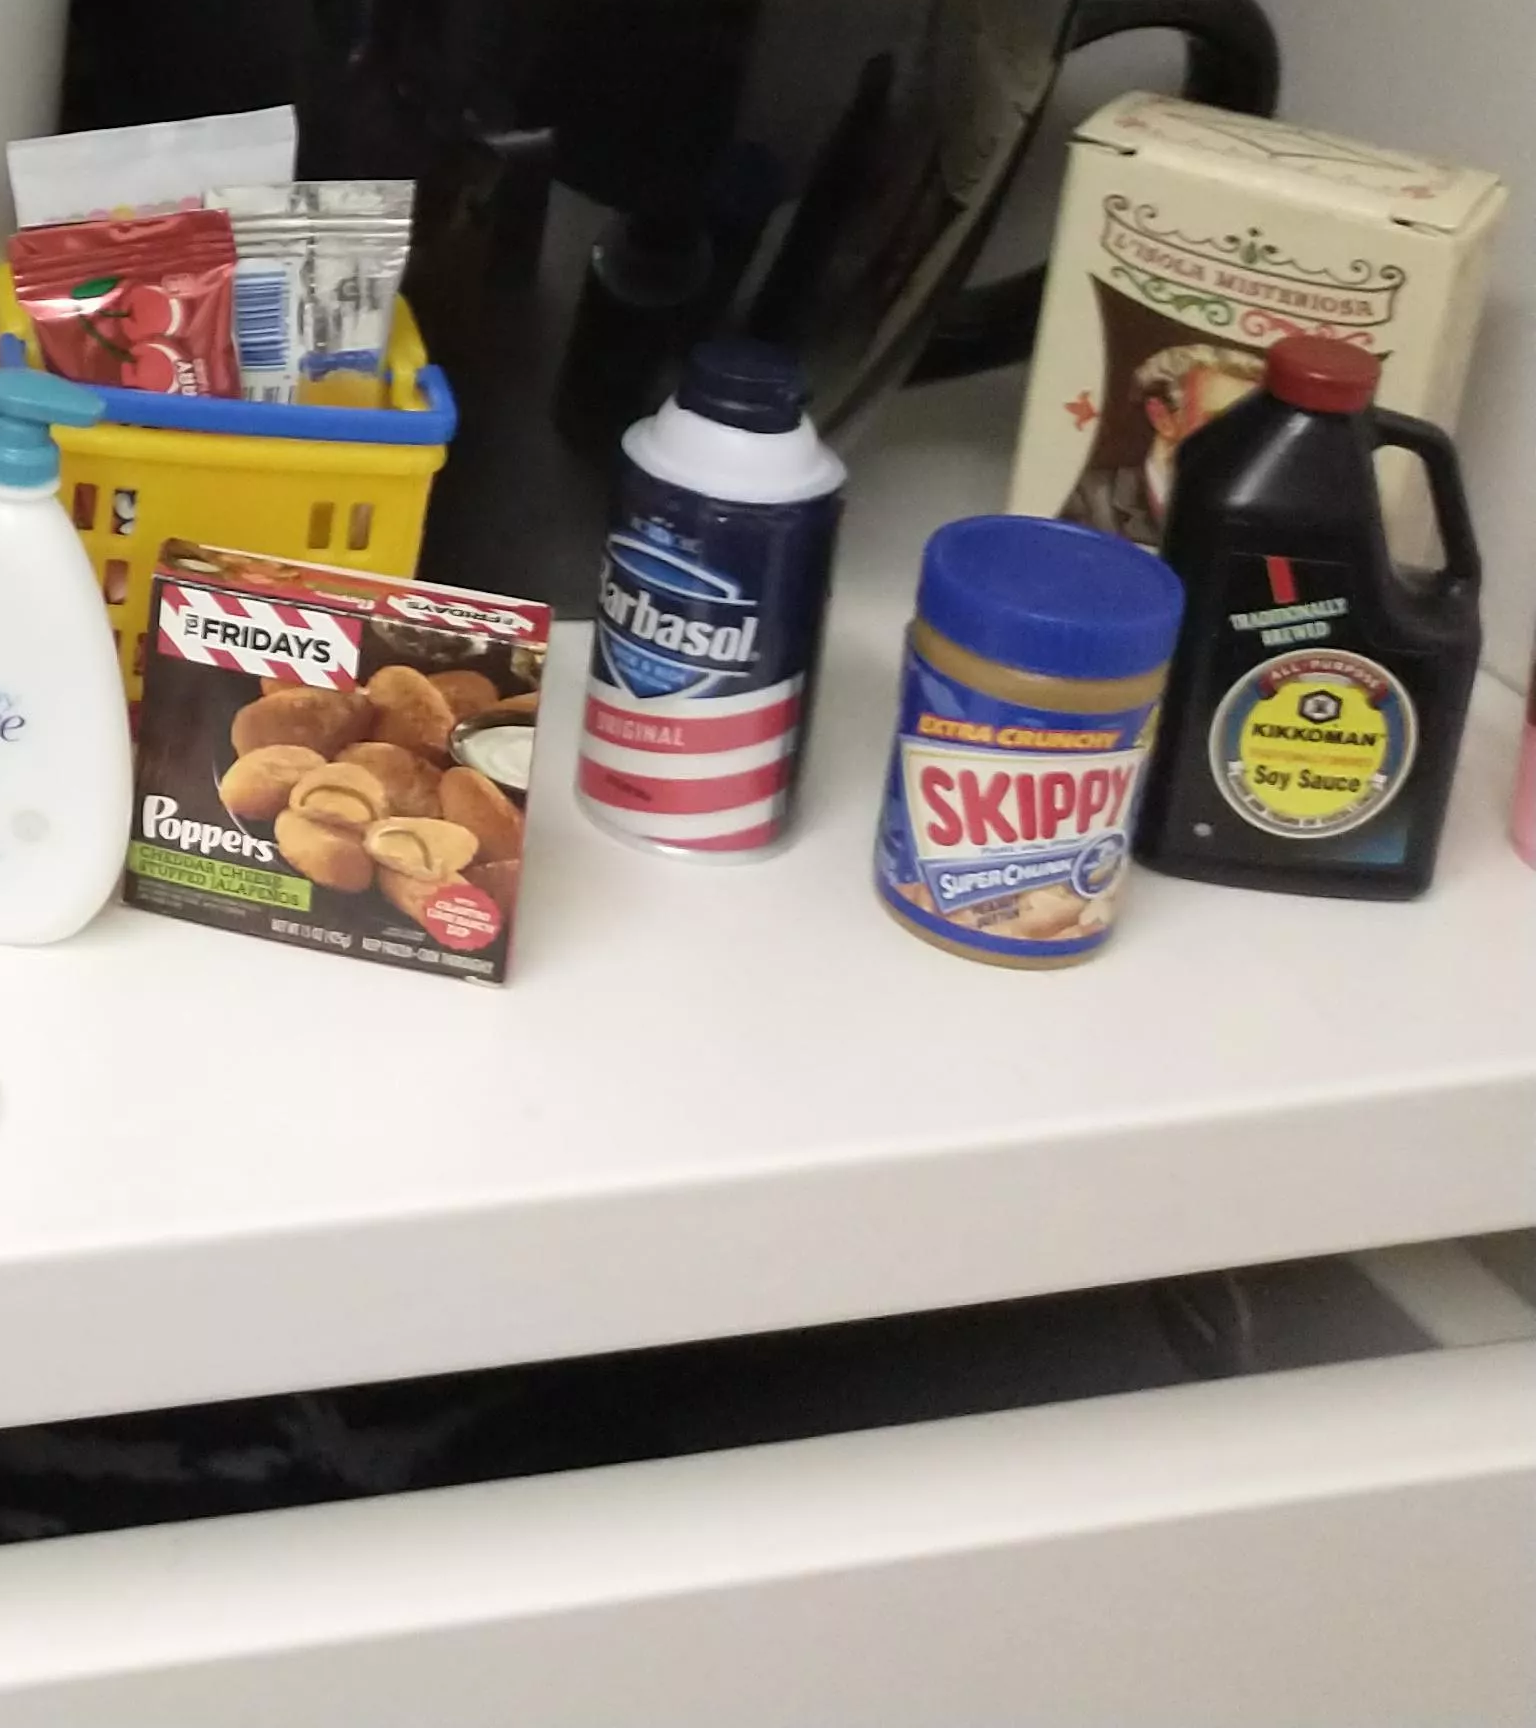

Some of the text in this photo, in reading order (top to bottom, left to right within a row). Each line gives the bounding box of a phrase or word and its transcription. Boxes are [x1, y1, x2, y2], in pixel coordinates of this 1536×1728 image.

[1213, 269, 1376, 319] MISTERIOSA
[201, 617, 333, 665] FRIDAYS
[1309, 658, 1384, 690] PURPOSE
[595, 710, 686, 748] ORIGINAL
[1250, 721, 1377, 748] KIKKOMAN
[1253, 764, 1363, 794] Soy Sauce
[920, 763, 1135, 848] SKIPPY
[141, 793, 275, 864] Poppers
[139, 845, 215, 875] CHEDDAR
